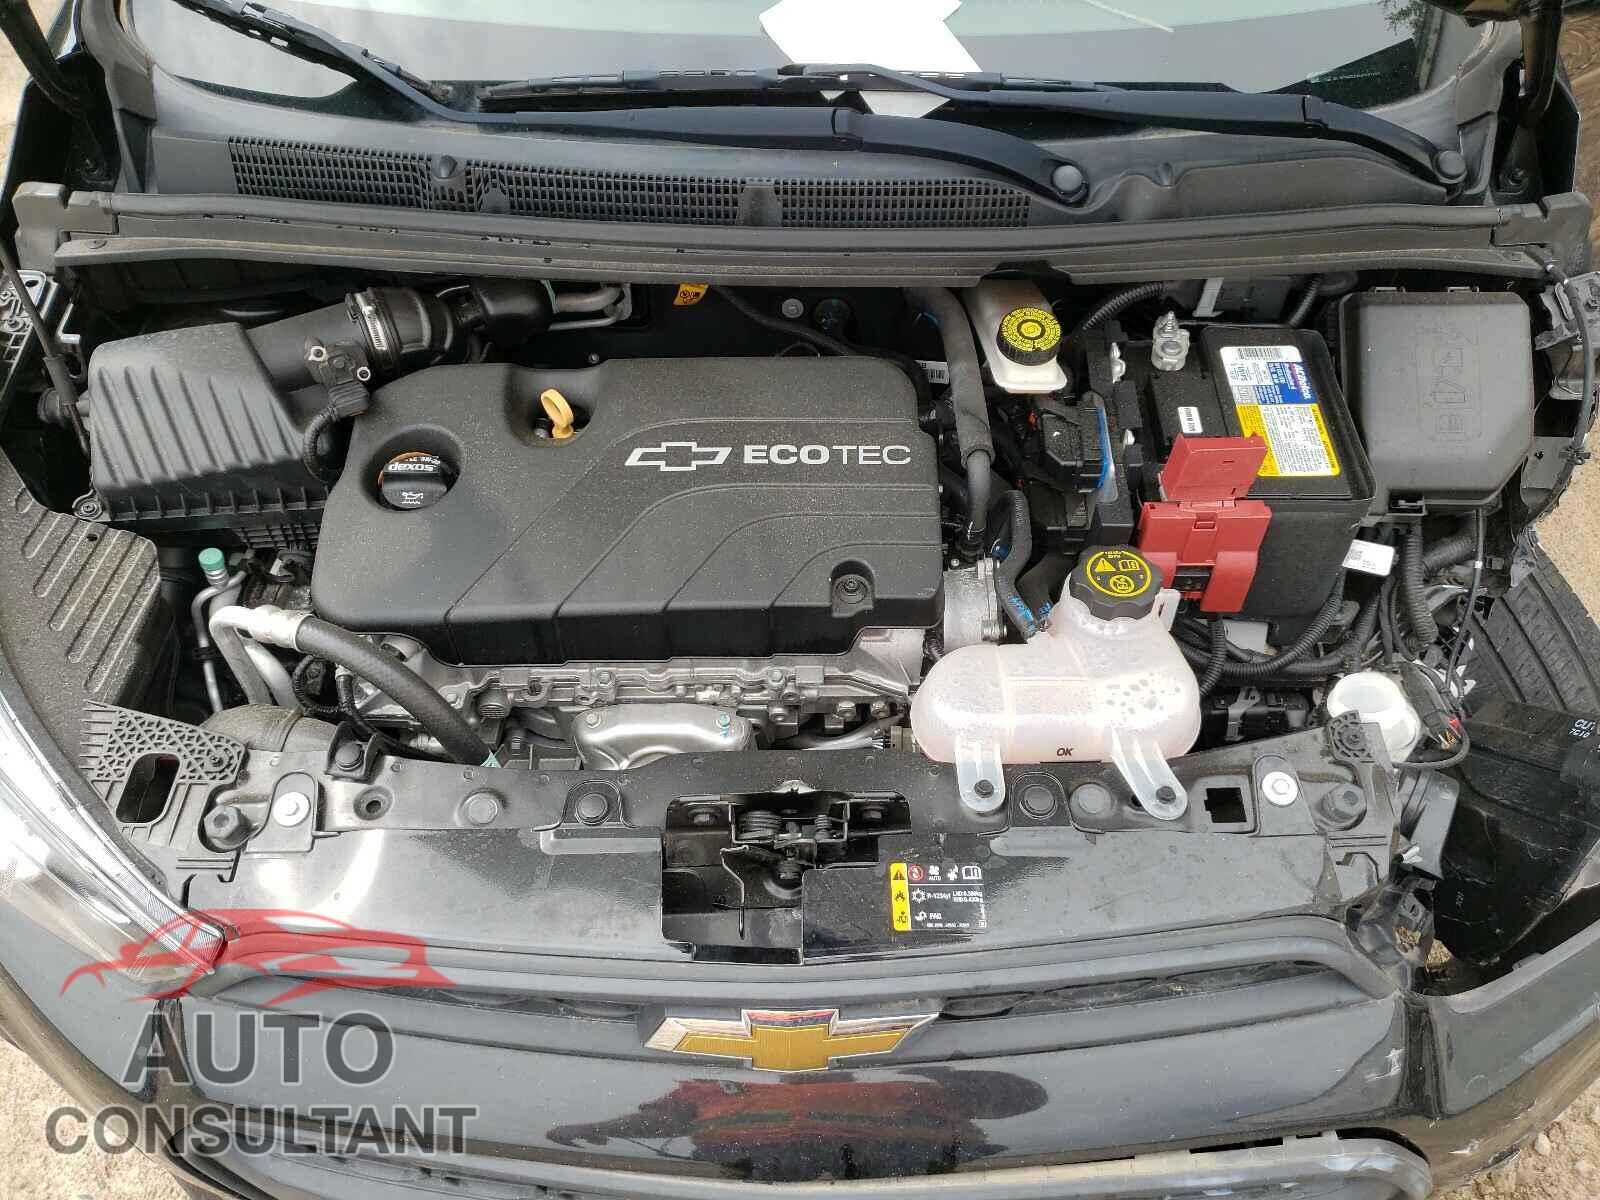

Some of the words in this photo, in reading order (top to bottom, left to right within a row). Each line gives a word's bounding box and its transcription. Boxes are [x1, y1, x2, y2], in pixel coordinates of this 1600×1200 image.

[743, 444, 911, 465] ECOTEC
[388, 462, 437, 472] dexos
[1056, 747, 1074, 757] OK
